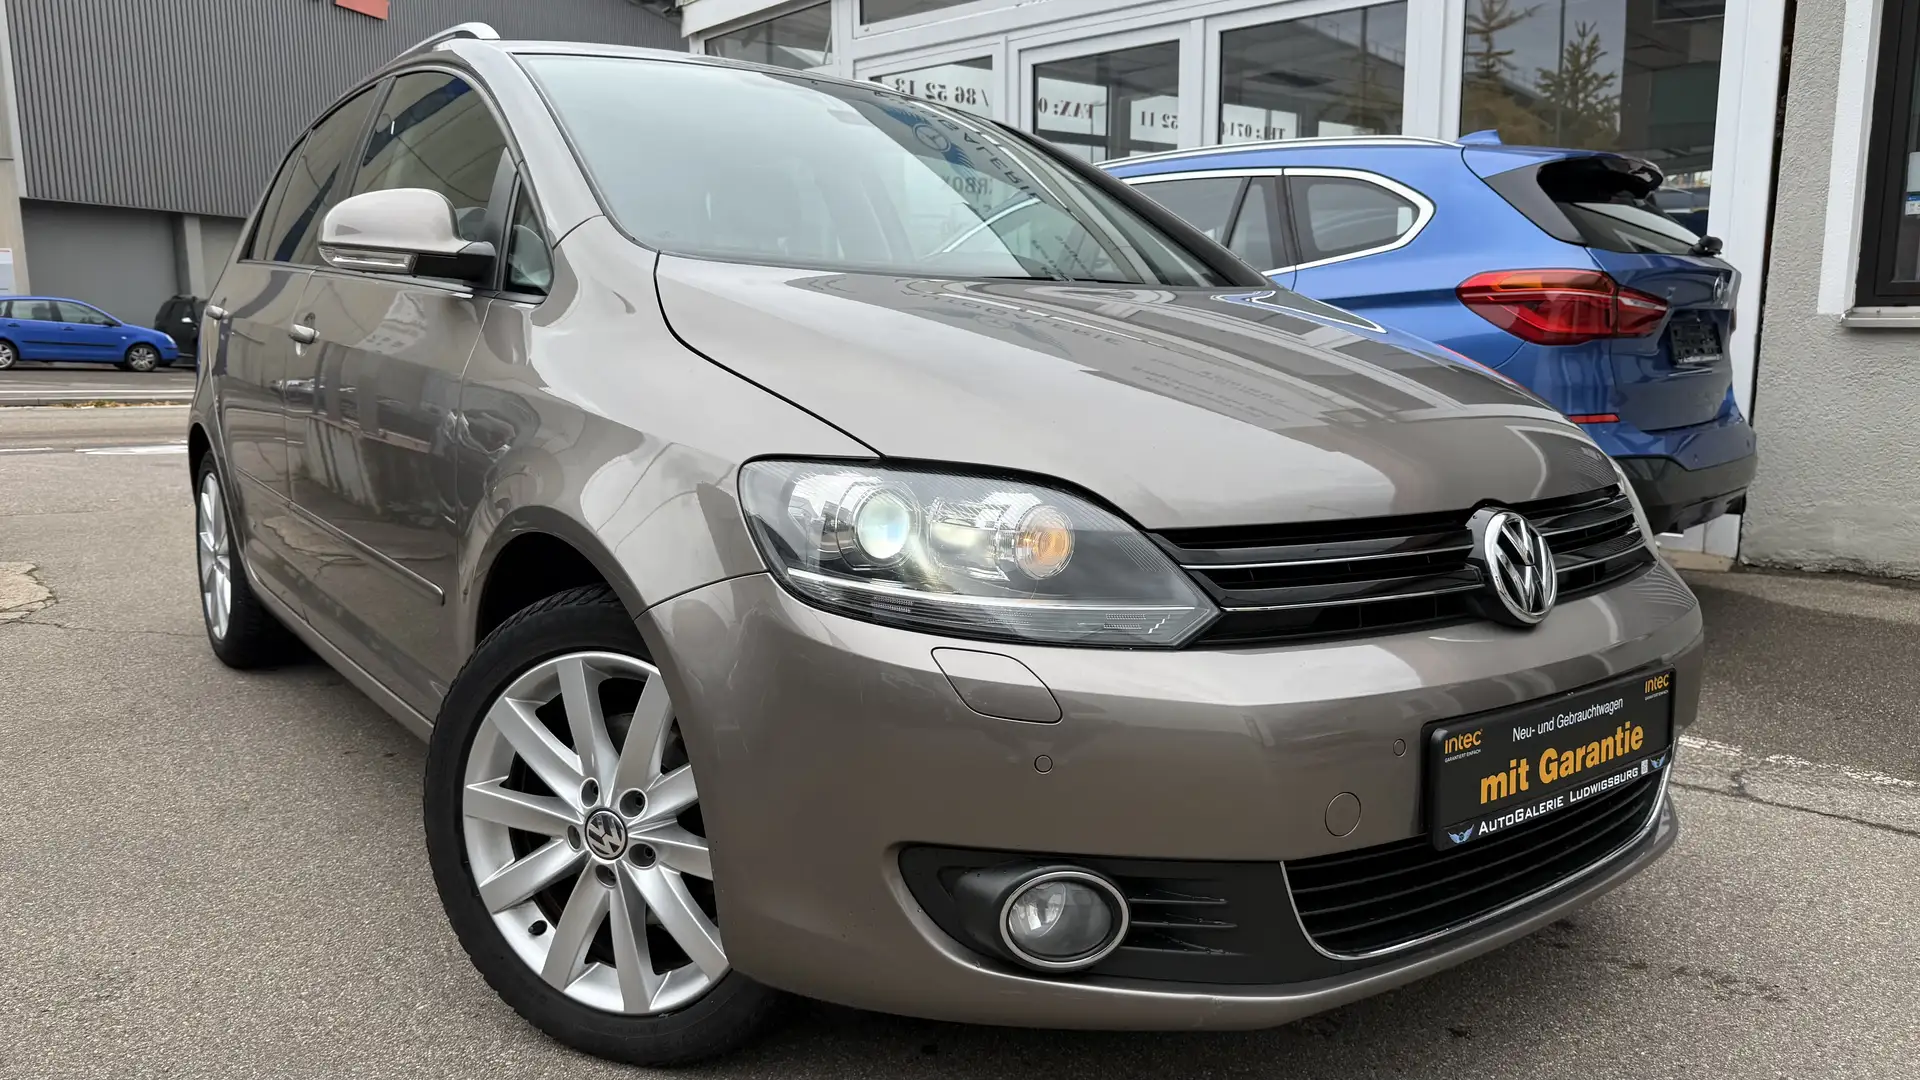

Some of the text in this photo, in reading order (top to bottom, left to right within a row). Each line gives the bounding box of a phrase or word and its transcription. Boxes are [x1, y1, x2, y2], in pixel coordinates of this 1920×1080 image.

[1512, 697, 1624, 742] Neu- und Gebrauchtwagen
[1480, 720, 1644, 804] mit Garantie
